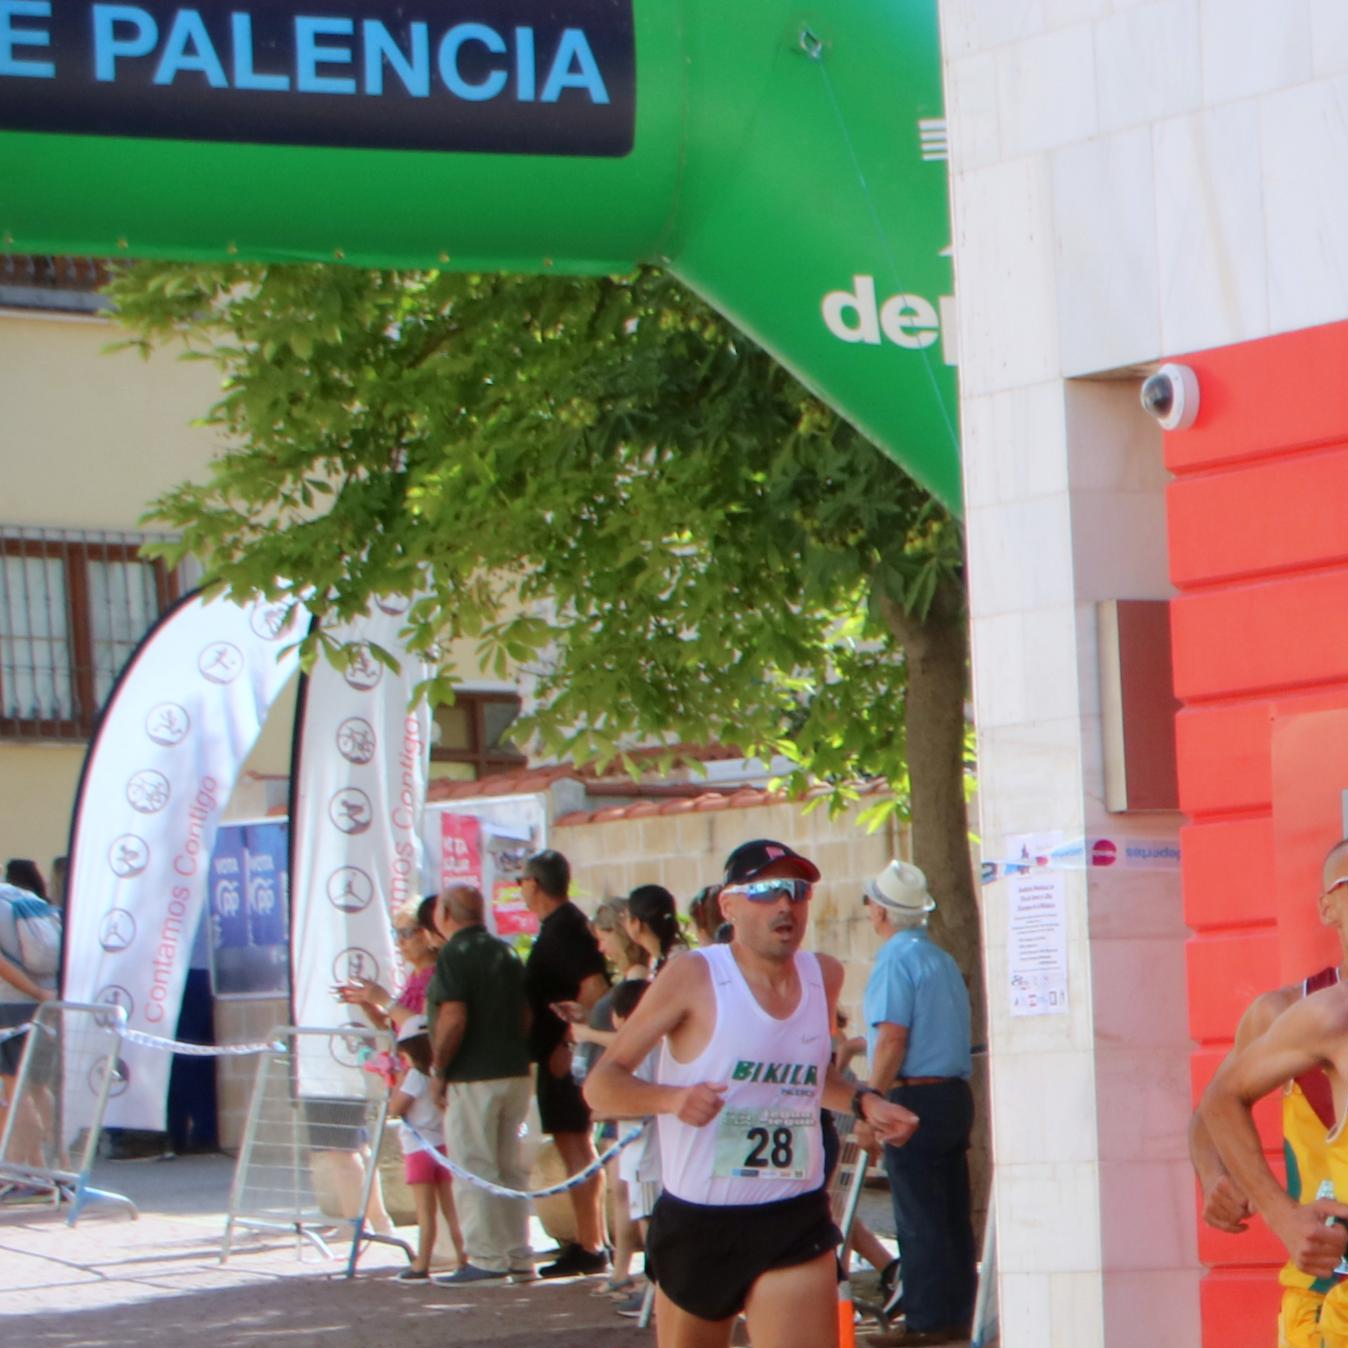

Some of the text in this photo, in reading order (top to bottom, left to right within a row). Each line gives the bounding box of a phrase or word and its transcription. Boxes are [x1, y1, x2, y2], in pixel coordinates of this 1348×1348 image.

[0, 0, 611, 105] E PALENCIA
[391, 717, 424, 831] Contigo
[143, 774, 219, 1025] Contamos Contigo
[731, 1060, 818, 1086] BIKILA
[744, 1127, 793, 1169] 28
